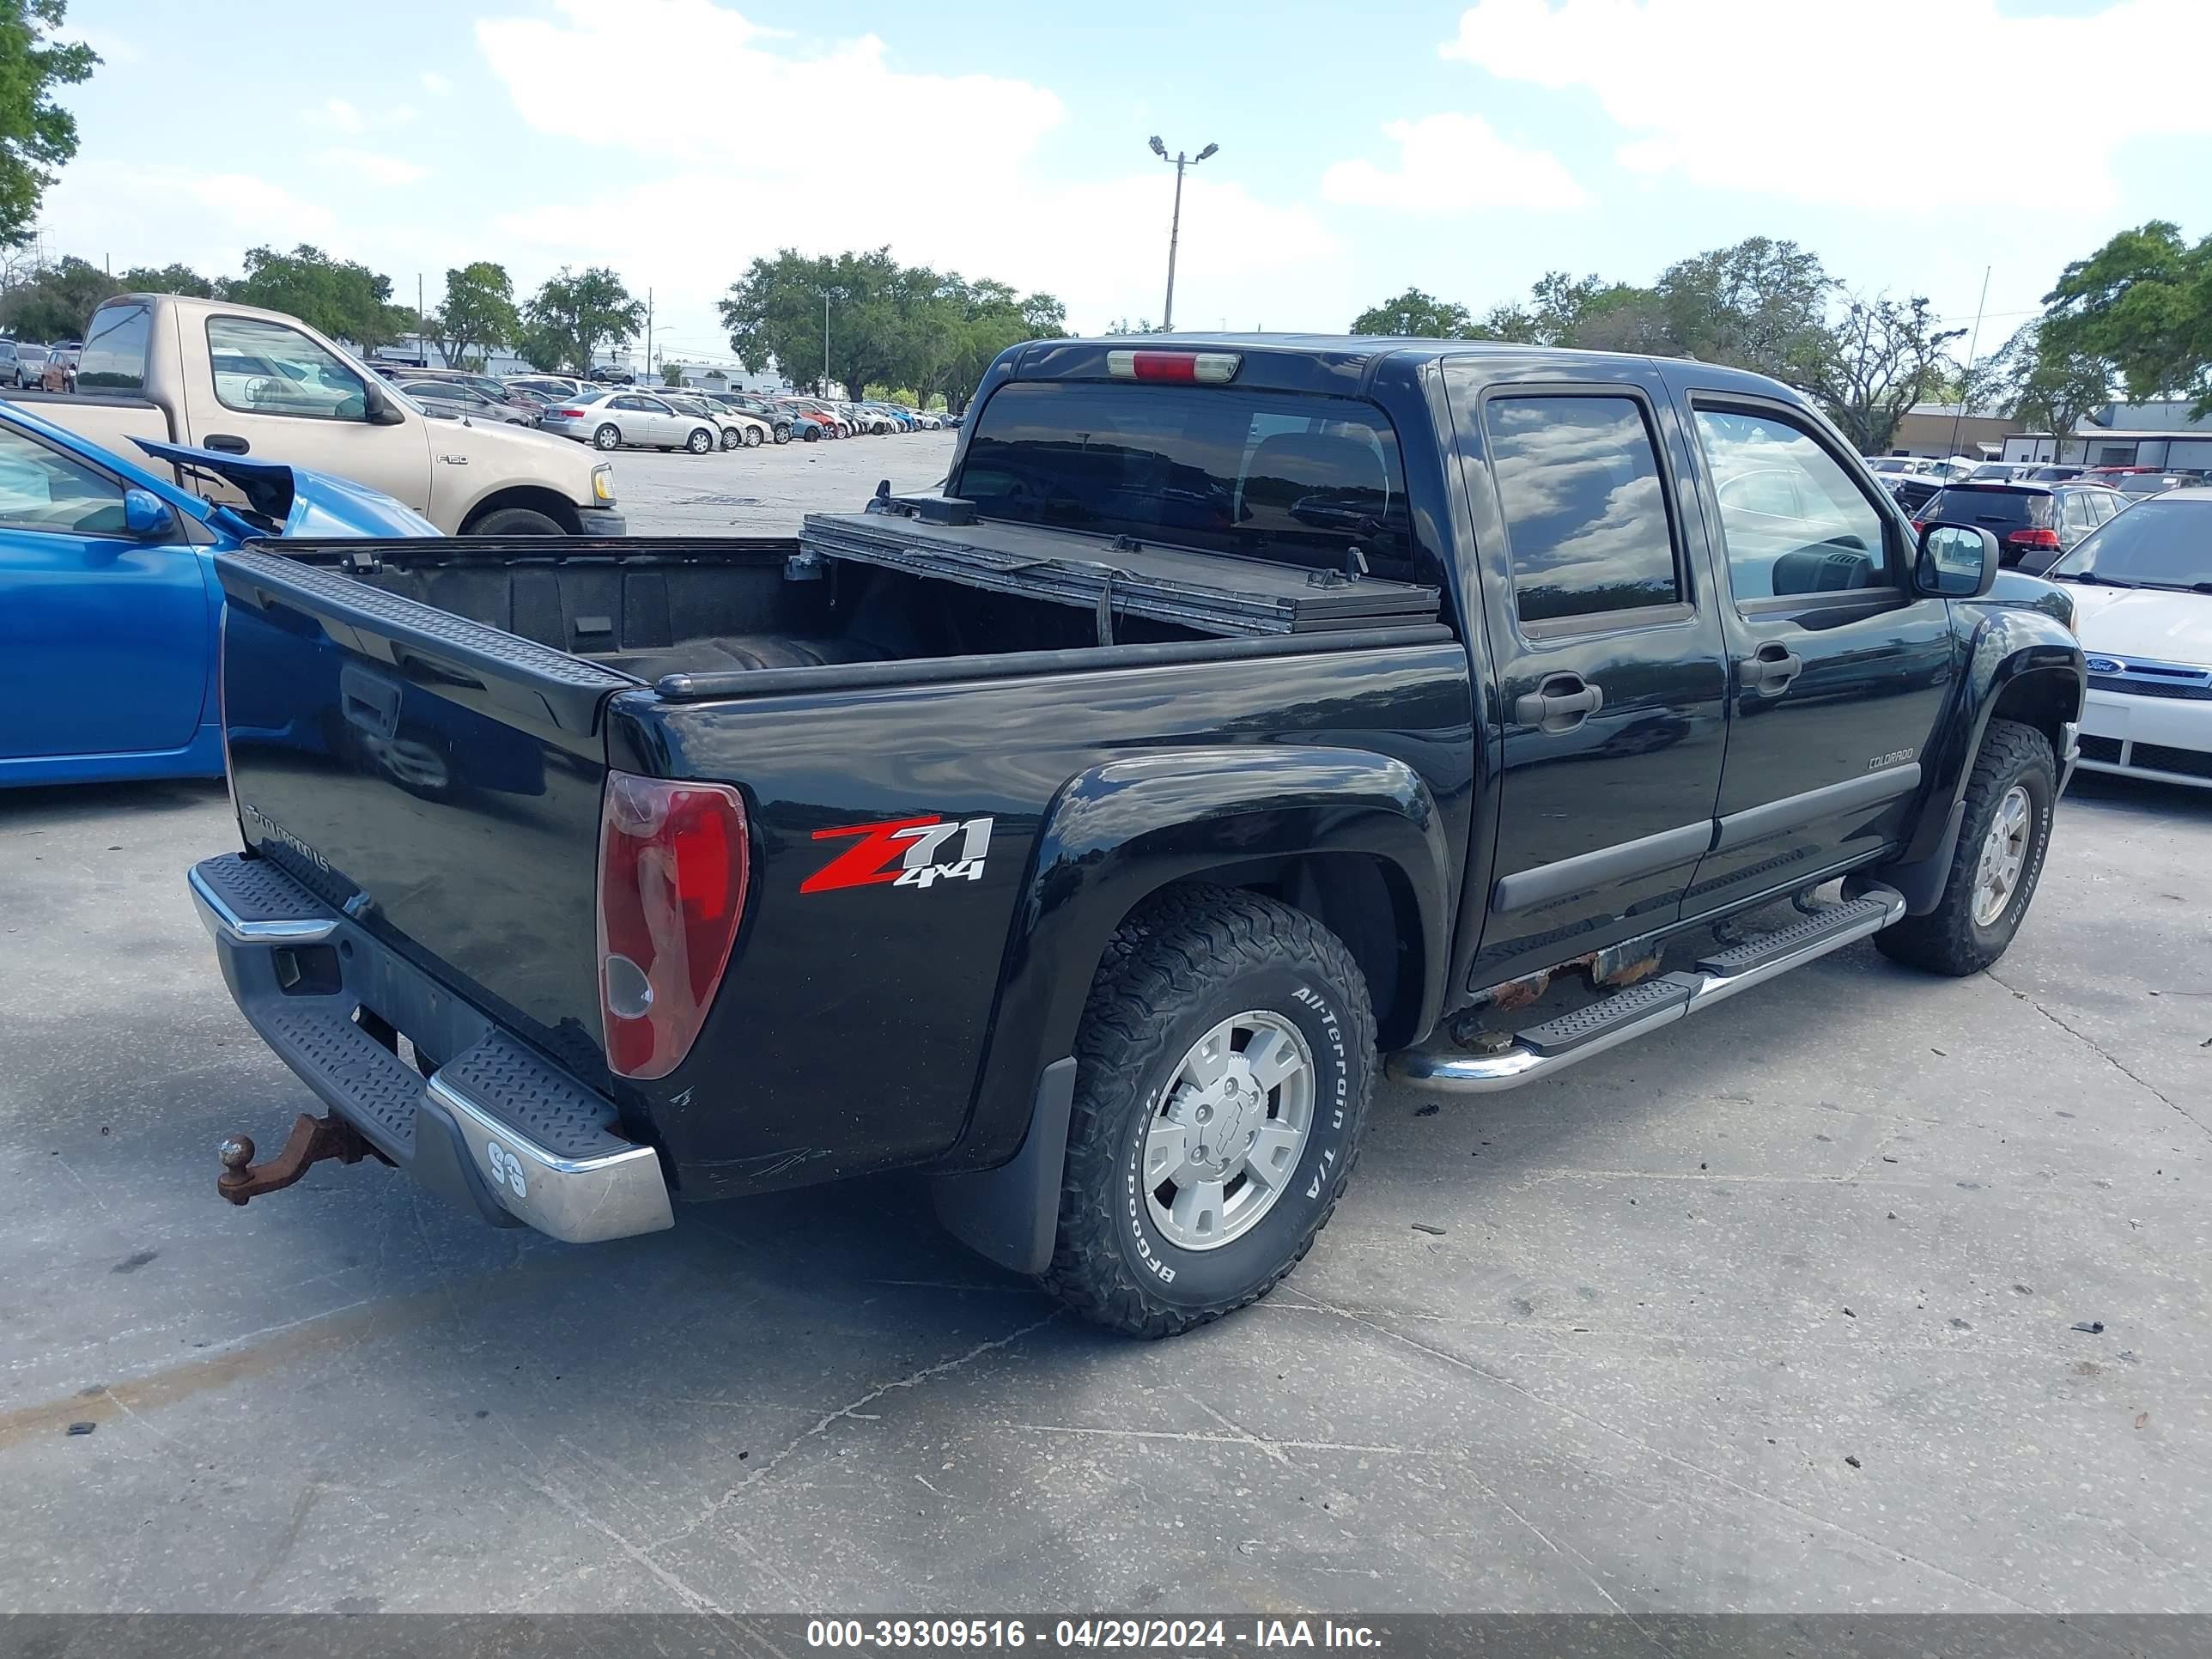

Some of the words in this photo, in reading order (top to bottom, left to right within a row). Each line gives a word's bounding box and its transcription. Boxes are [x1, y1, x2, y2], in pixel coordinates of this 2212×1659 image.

[2087, 659, 2113, 672] Ford
[1867, 746, 1914, 770] COLORADO
[799, 814, 994, 895] Z71
[892, 859, 987, 890] 4x4
[2009, 806, 2050, 927] BFGoodrich
[1291, 987, 1348, 1130] All-Terrain
[1127, 1087, 1177, 1284] BFGoodrich
[1305, 1147, 1337, 1200] T/A
